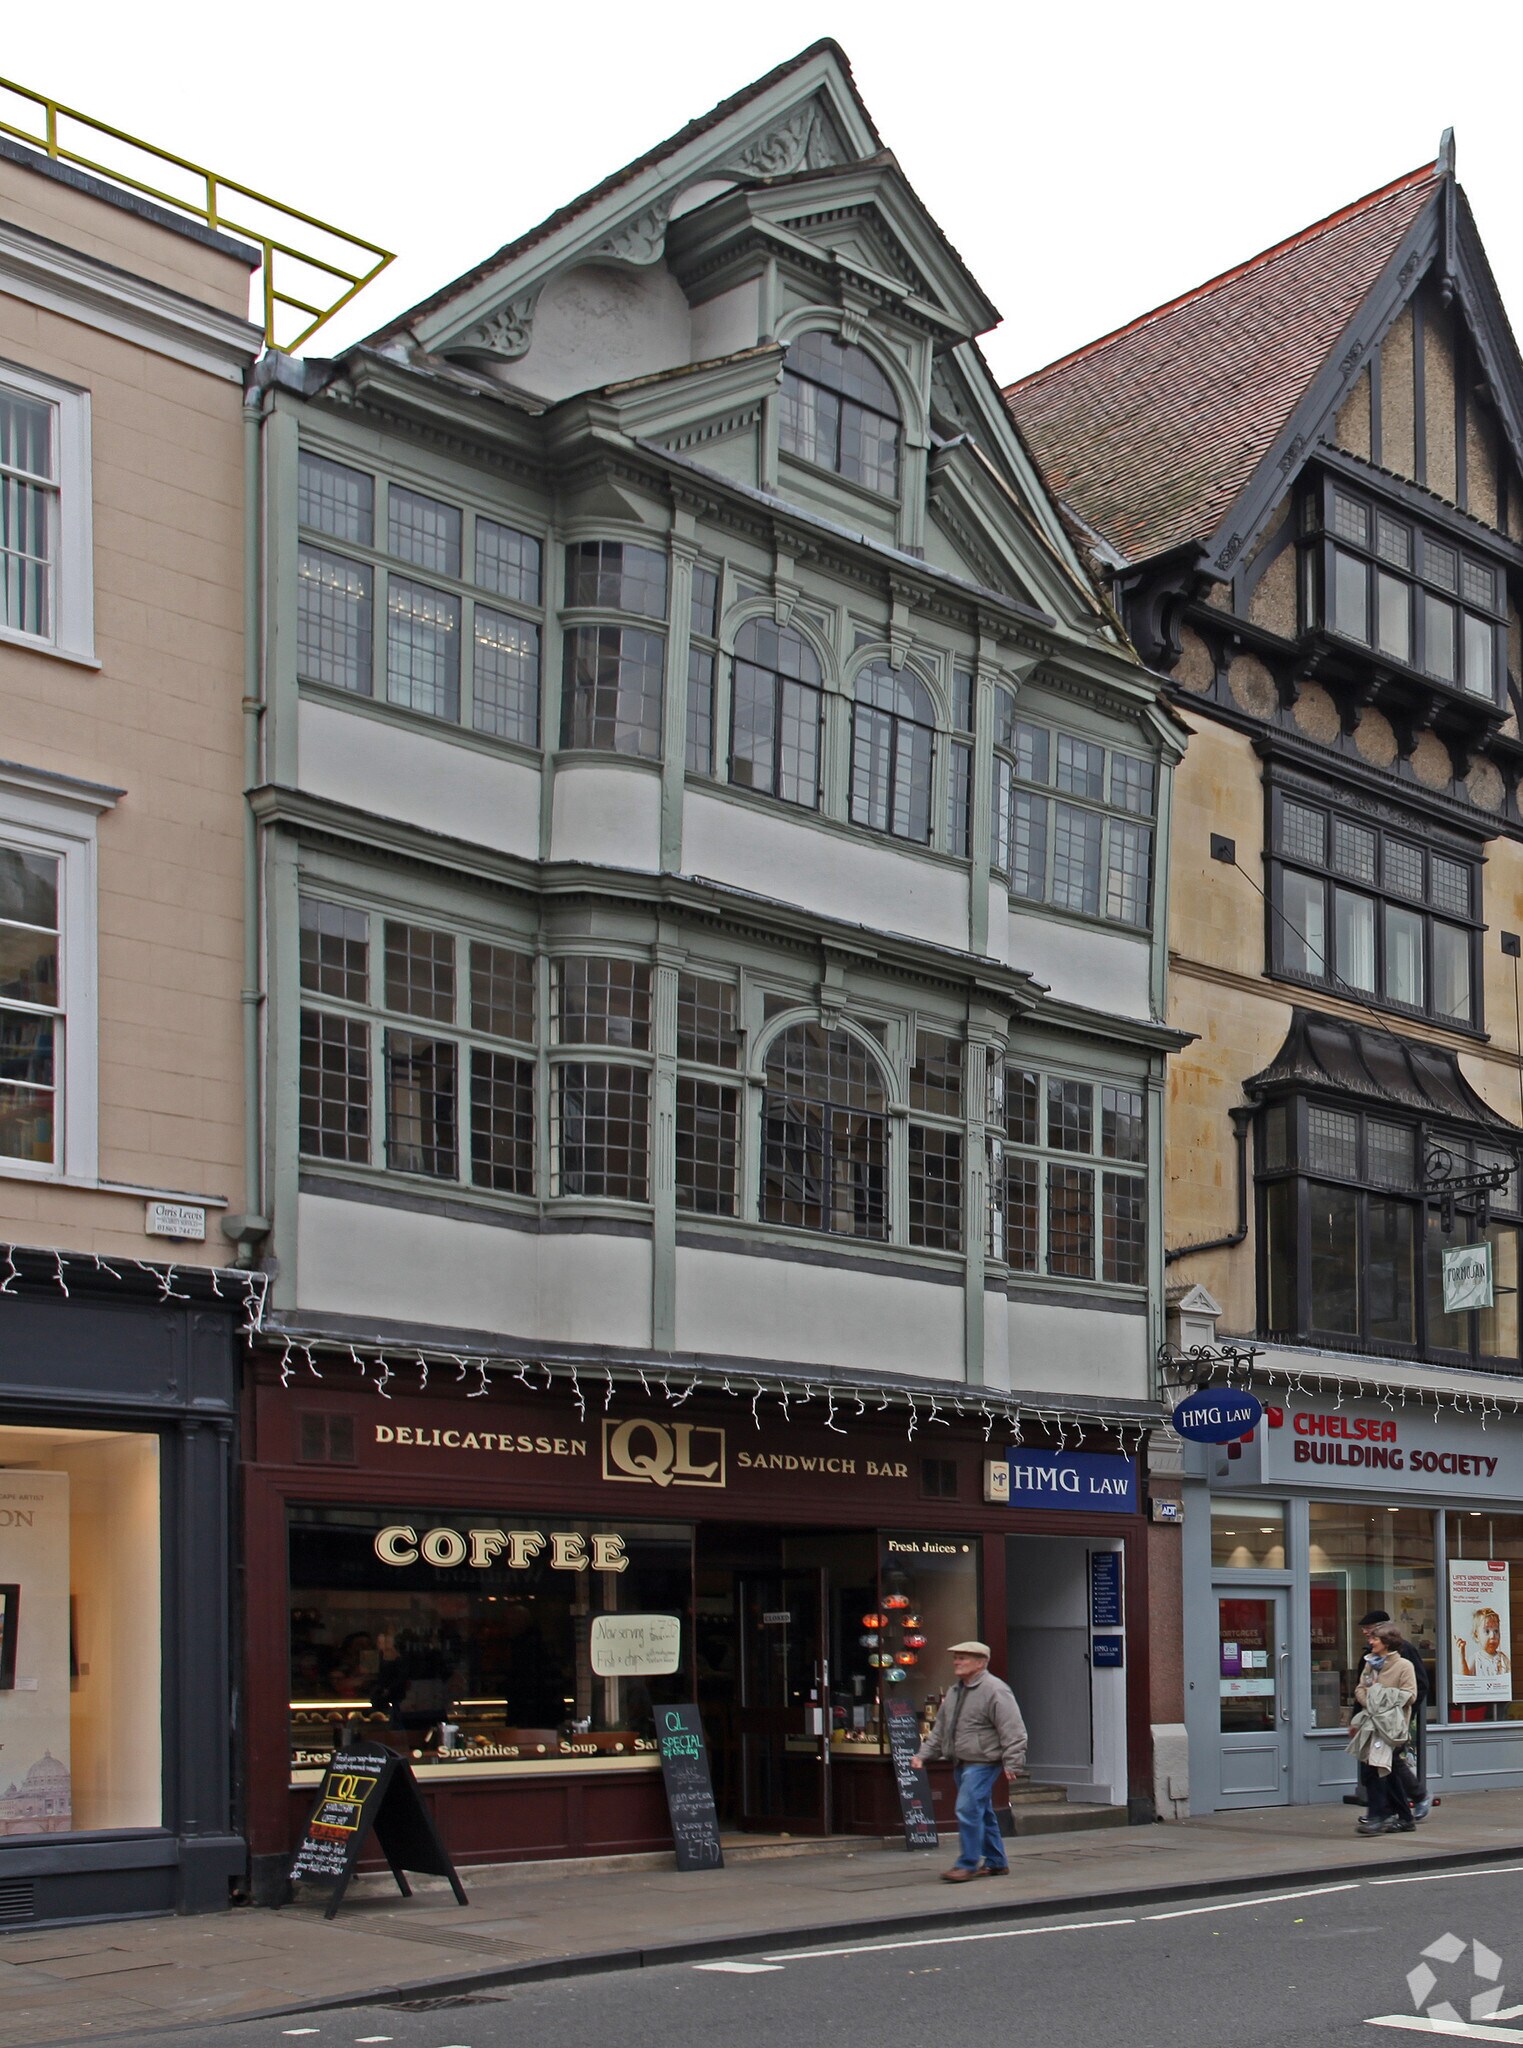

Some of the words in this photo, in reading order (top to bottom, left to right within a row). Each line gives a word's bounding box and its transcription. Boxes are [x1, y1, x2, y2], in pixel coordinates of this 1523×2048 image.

[155, 1205, 177, 1217] Chris
[179, 1207, 203, 1220] Lewis
[1182, 1407, 1221, 1428] HMG
[1226, 1407, 1252, 1423] LAW
[1293, 1412, 1398, 1443] CHELSEA
[375, 1424, 588, 1457] DELICATESSEN
[610, 1418, 719, 1488] QL
[737, 1451, 856, 1475] SANDWICH
[866, 1459, 909, 1478] BAR
[1294, 1439, 1405, 1471] BUILDING
[1410, 1449, 1500, 1478] SOCIETY
[1014, 1465, 1081, 1493] HMG
[1089, 1477, 1129, 1496] LAW
[1161, 1504, 1177, 1518] ADT
[374, 1525, 630, 1573] COFFEE
[888, 1540, 920, 1553] Fresh
[922, 1541, 957, 1554] Juices
[665, 1711, 689, 1732] QL
[296, 1750, 336, 1763] Fres
[437, 1744, 520, 1759] Smoothies
[559, 1742, 598, 1756] Soup
[634, 1737, 658, 1751] Sal
[662, 1734, 703, 1750] SPECIAL
[338, 1774, 359, 1801] QL
